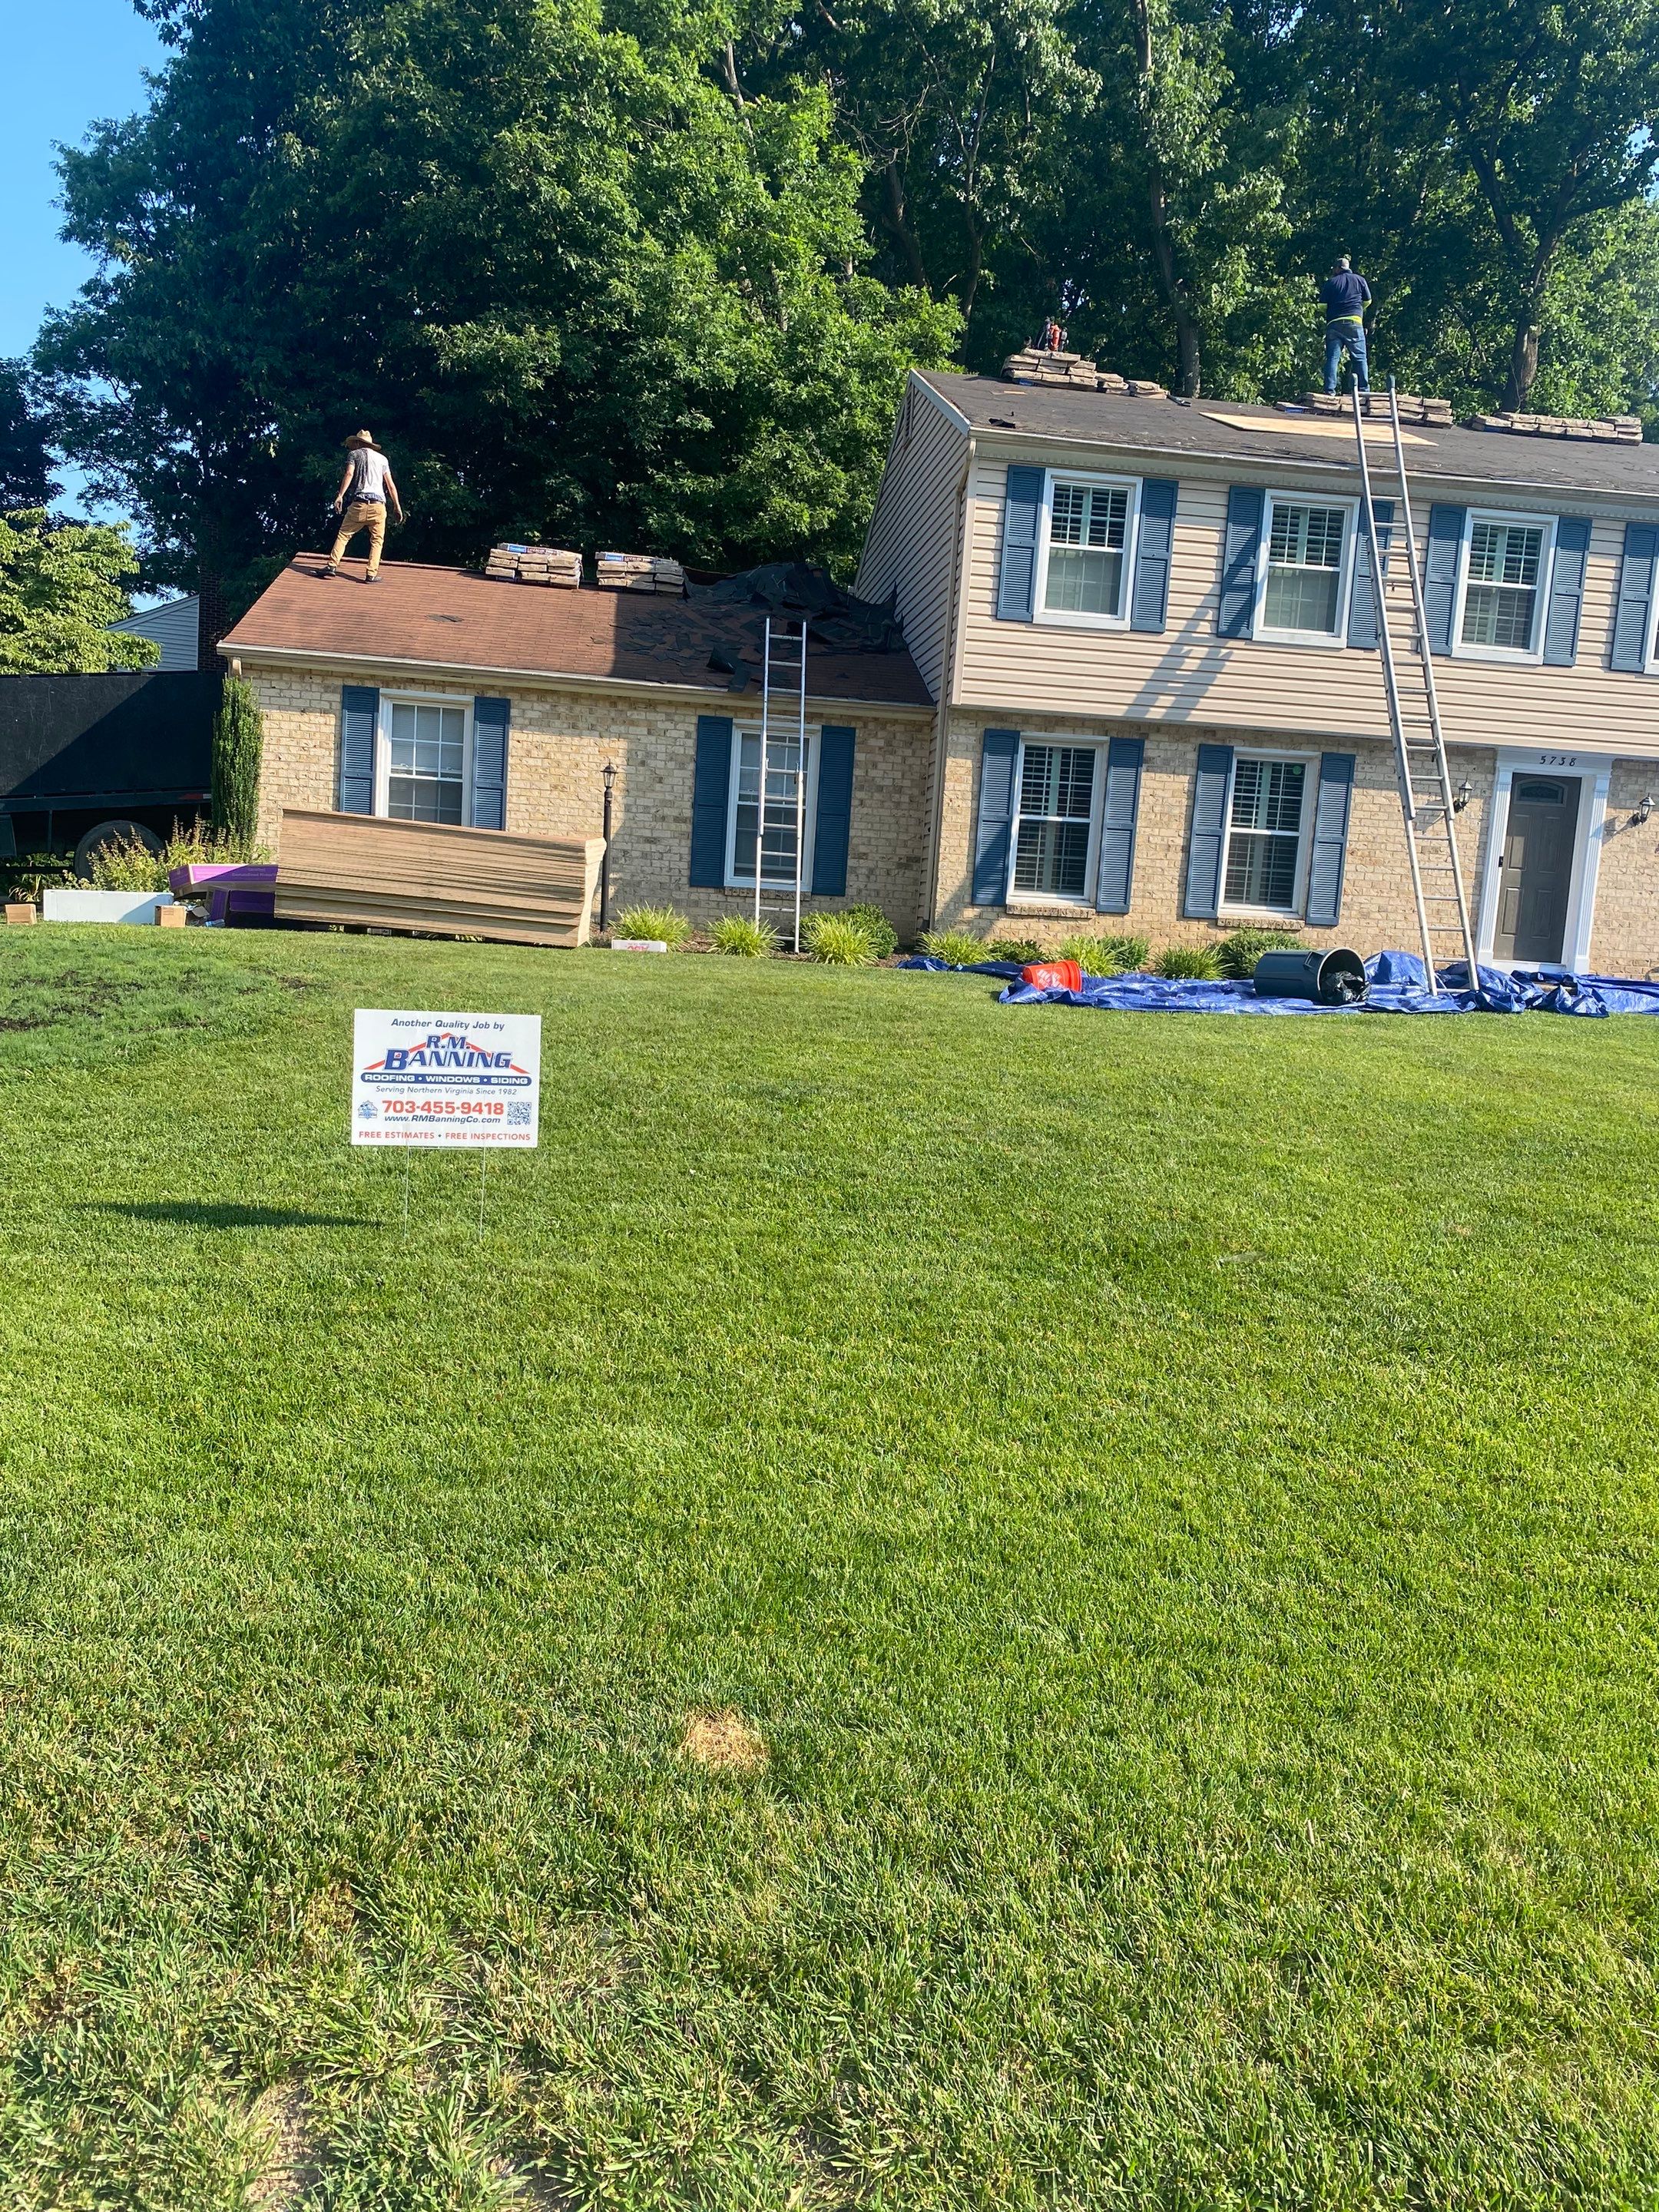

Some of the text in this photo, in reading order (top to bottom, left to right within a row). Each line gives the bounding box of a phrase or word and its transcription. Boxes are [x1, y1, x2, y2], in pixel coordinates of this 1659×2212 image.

[1539, 756, 1577, 767] 5738
[391, 1018, 432, 1028] Another
[435, 1020, 469, 1030] Quality
[493, 1022, 505, 1031] by
[426, 1035, 471, 1049] R.M.
[384, 1049, 512, 1071] BANNING
[364, 1074, 416, 1082] ROOFING
[426, 1075, 481, 1084] WINDOWS
[376, 1085, 405, 1094] Serving
[445, 1087, 474, 1096] Virginia
[382, 1100, 505, 1115] 703-455-9418
[384, 1114, 501, 1124] www.RMBanningCo.com
